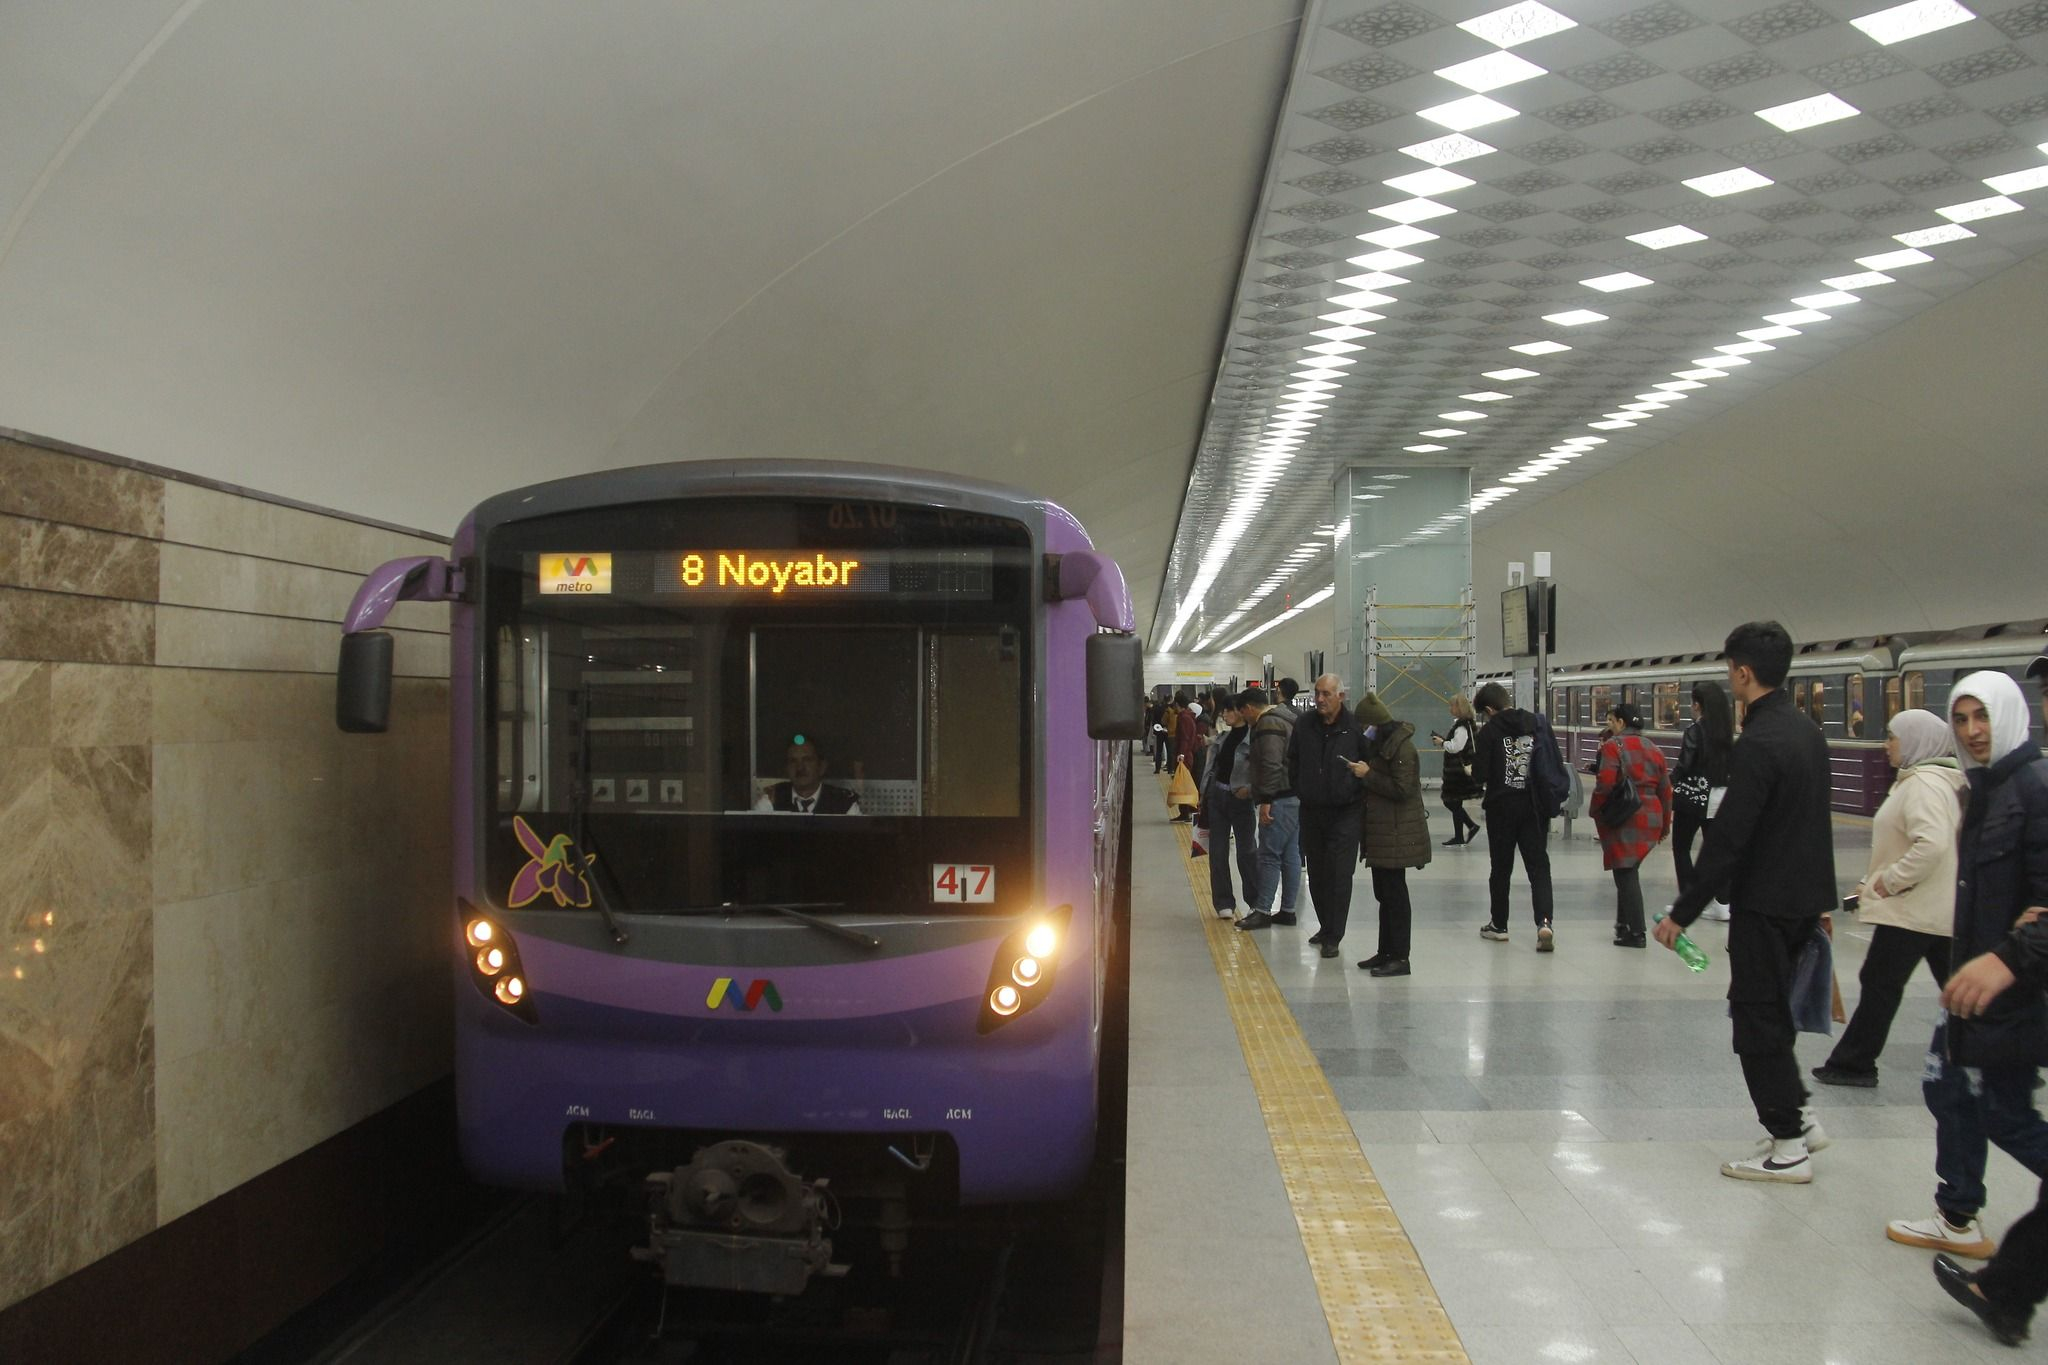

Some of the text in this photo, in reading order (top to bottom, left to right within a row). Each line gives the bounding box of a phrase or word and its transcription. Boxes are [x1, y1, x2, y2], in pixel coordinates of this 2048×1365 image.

[682, 553, 858, 593] 8 Noyabr
[556, 581, 593, 592] metro
